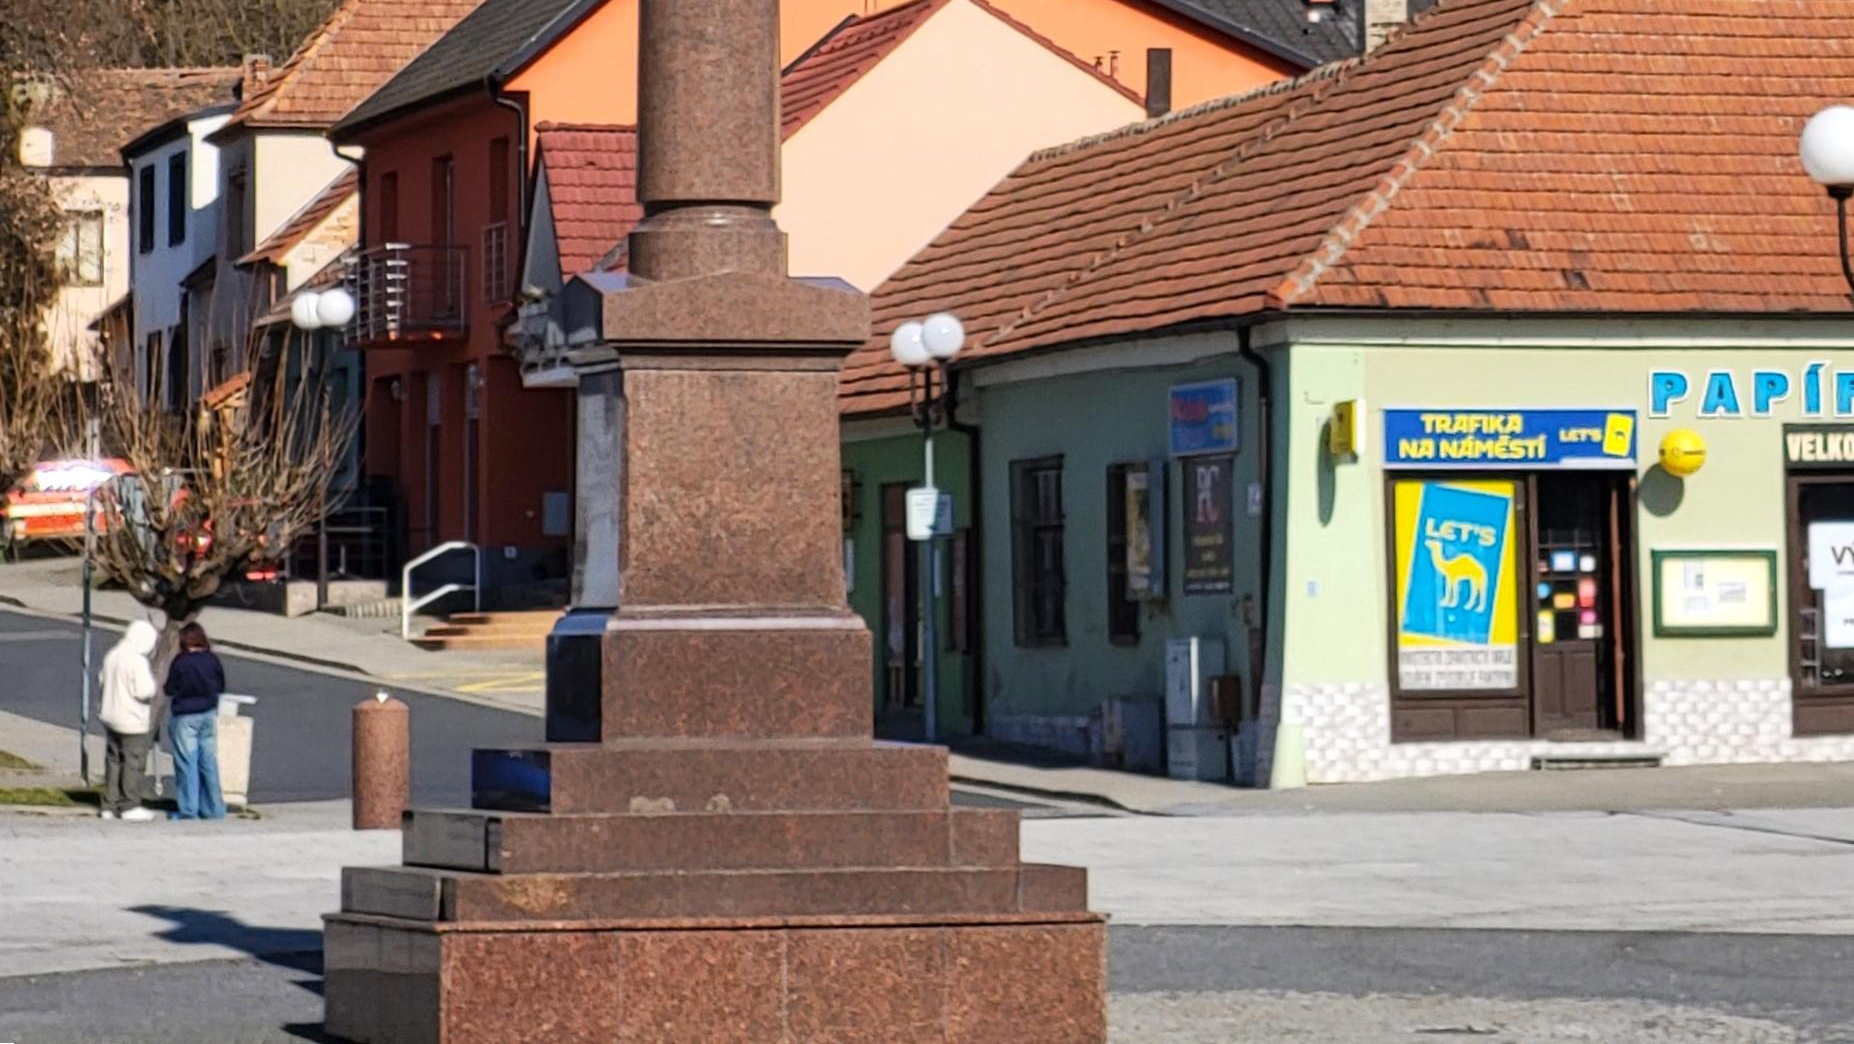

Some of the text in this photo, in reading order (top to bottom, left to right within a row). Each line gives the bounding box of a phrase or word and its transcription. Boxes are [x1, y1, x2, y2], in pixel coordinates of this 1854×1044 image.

[1420, 413, 1524, 434] TRAFIKA
[1399, 433, 1547, 459] NA NÁMĚSTÍ
[1425, 517, 1497, 547] LET'S
